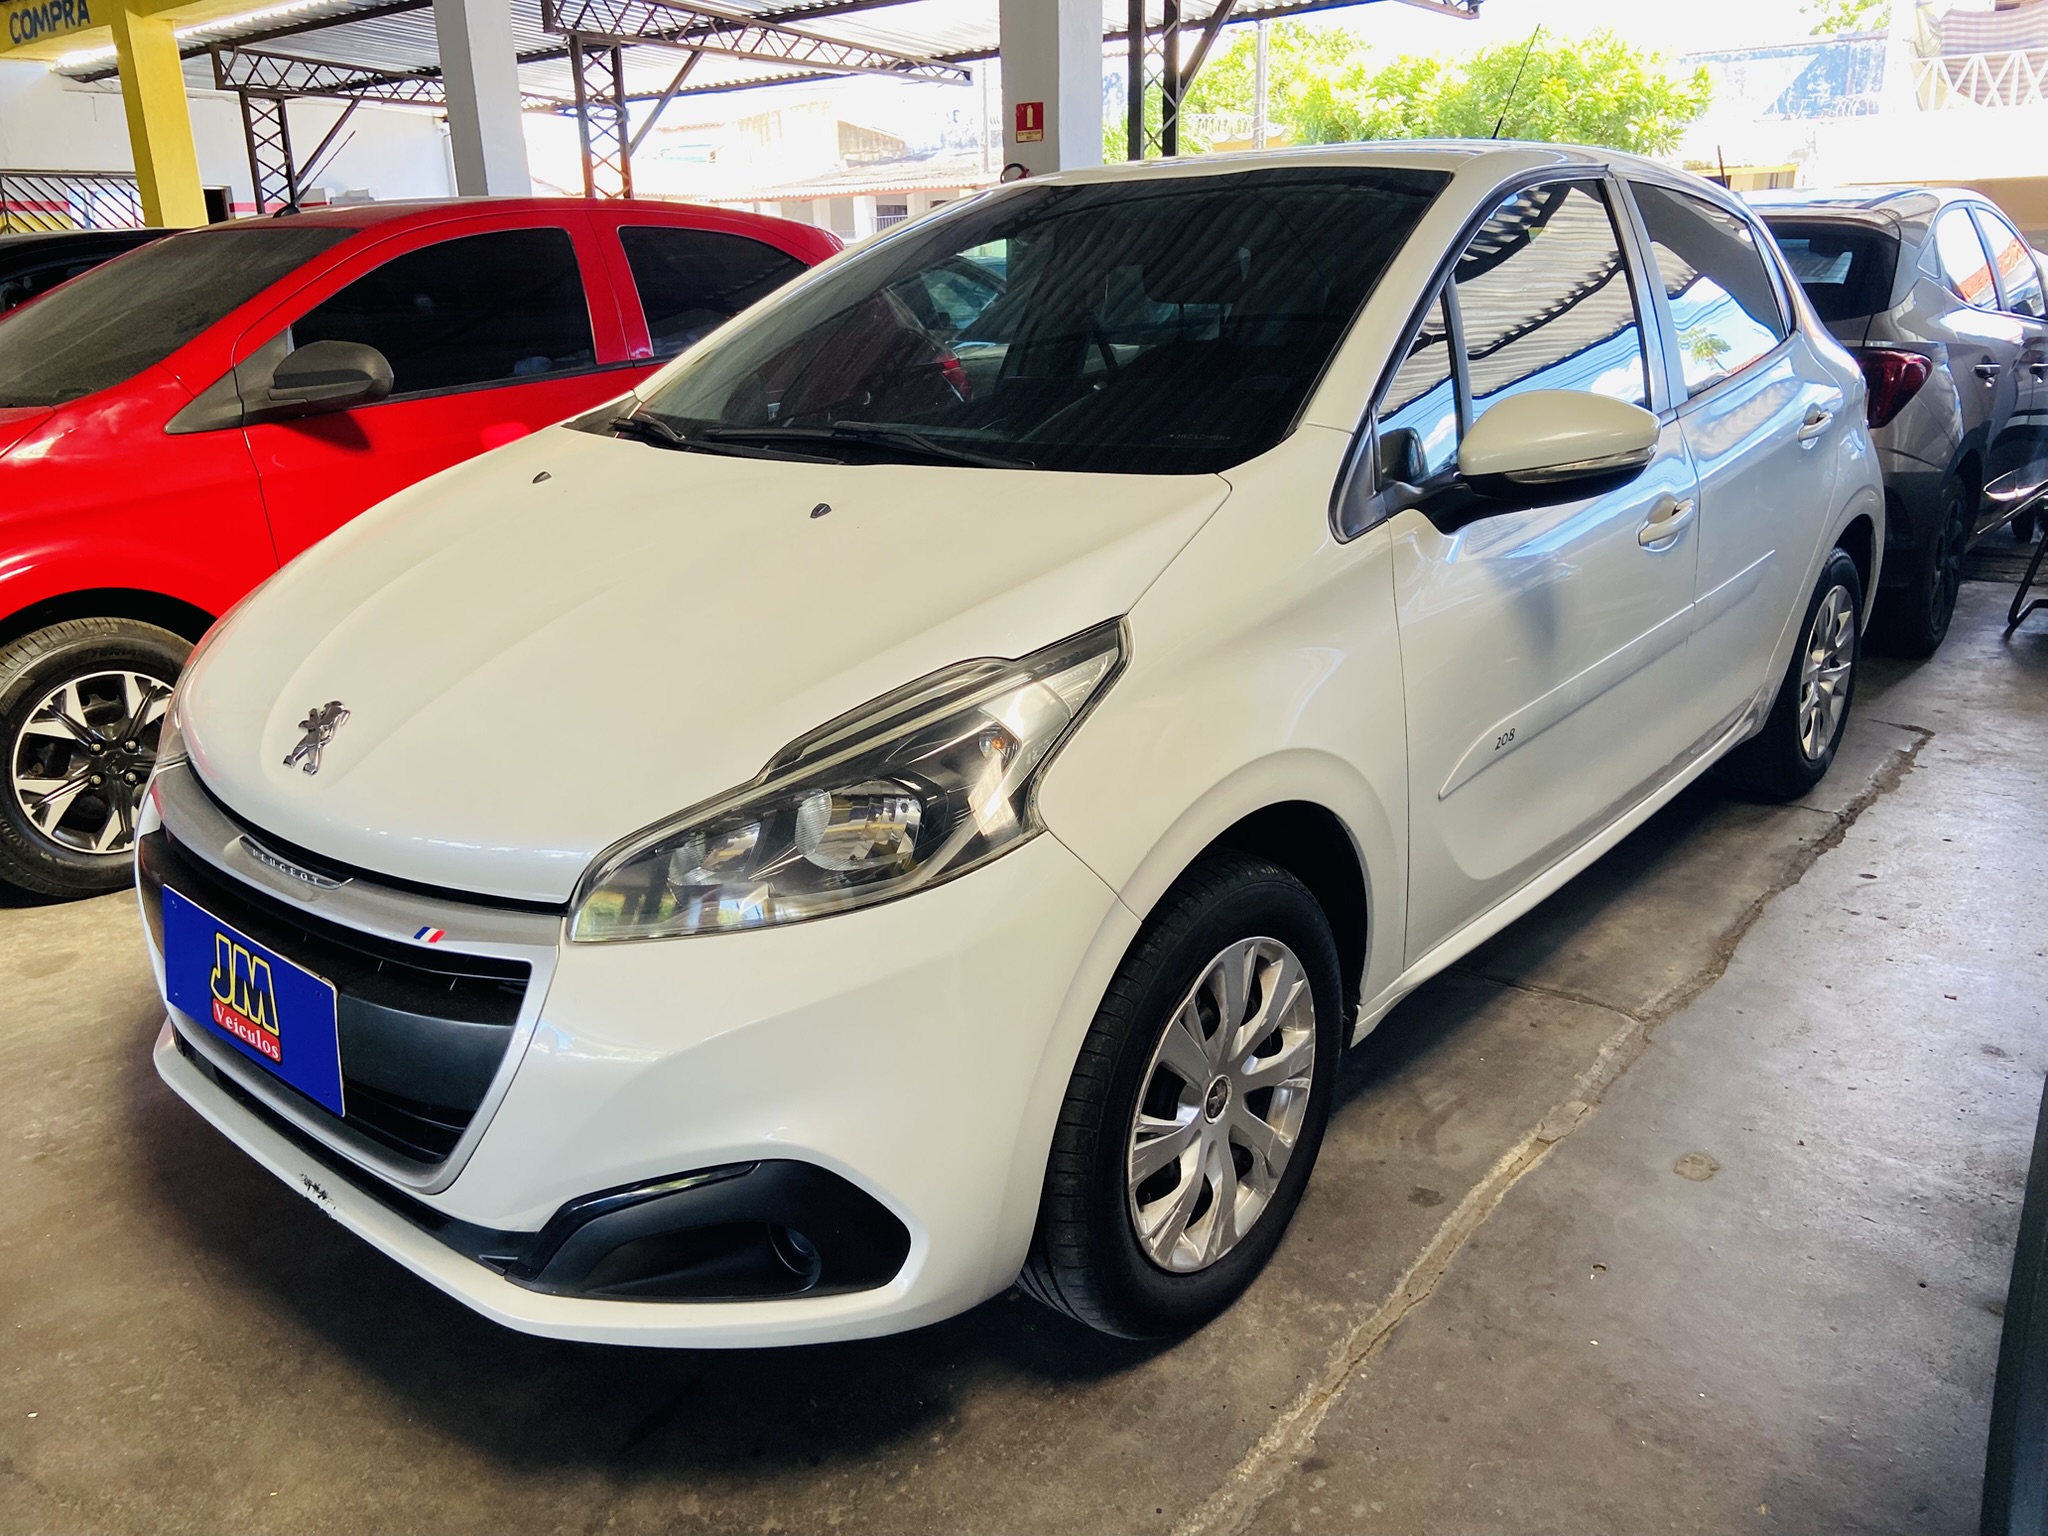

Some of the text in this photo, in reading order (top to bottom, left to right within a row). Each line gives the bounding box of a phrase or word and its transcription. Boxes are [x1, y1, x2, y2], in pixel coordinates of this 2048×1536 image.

[9, 0, 91, 44] COMPRA
[1494, 727, 1516, 751] 208
[252, 848, 319, 885] PEUGEOT
[210, 932, 280, 1037] JM
